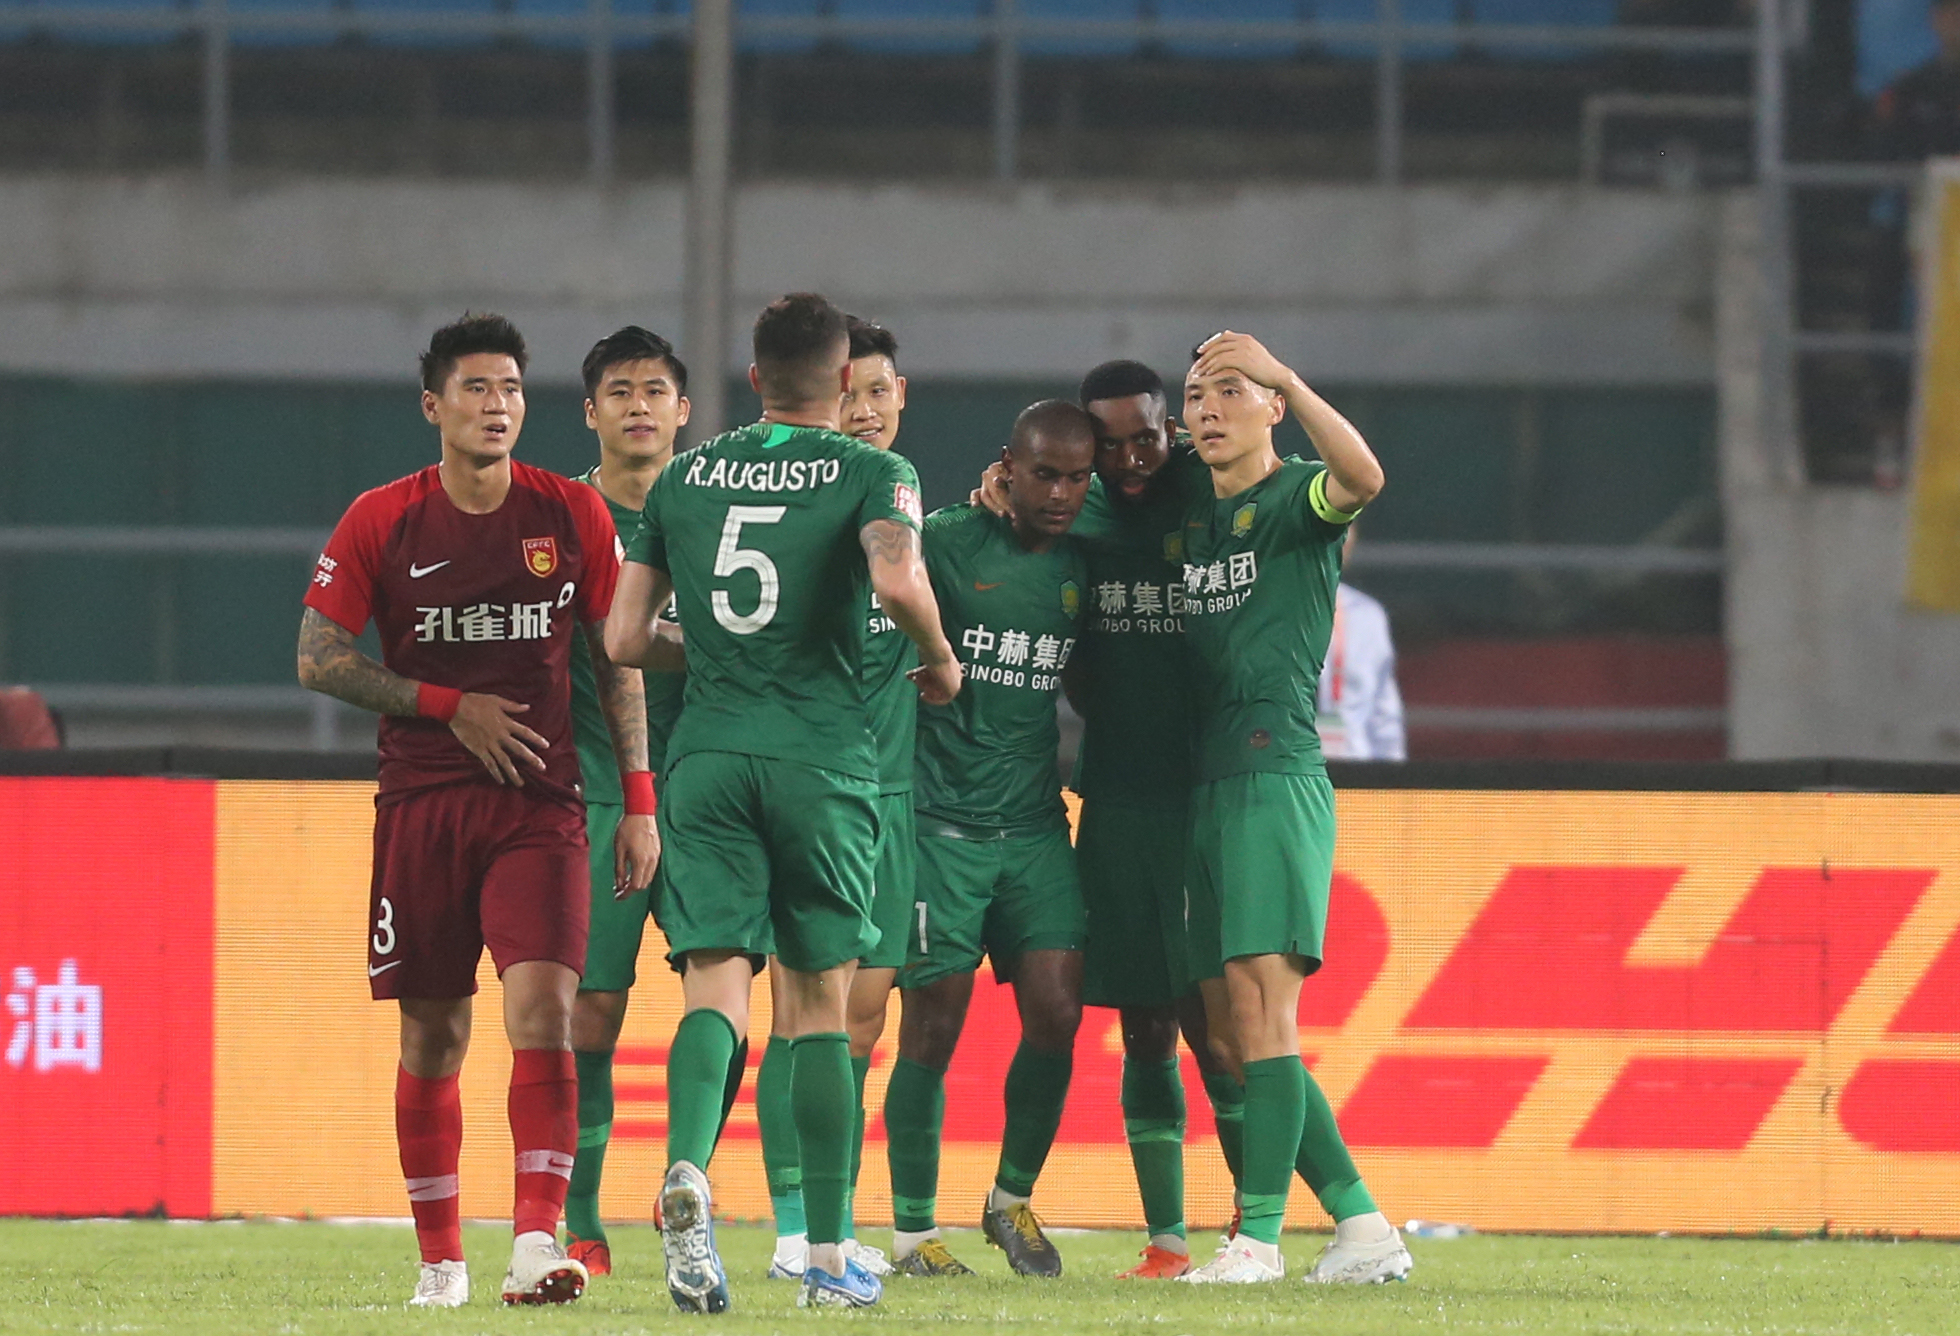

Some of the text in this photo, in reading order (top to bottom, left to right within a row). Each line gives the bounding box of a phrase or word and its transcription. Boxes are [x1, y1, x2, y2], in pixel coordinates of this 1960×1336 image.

[684, 455, 840, 492] R.AUGUSTO
[711, 505, 787, 635] 5
[414, 601, 553, 642] 孔雀城
[869, 616, 896, 634] SIN
[373, 897, 396, 956] 3
[914, 901, 929, 954] 1
[5, 957, 104, 1074] 油
